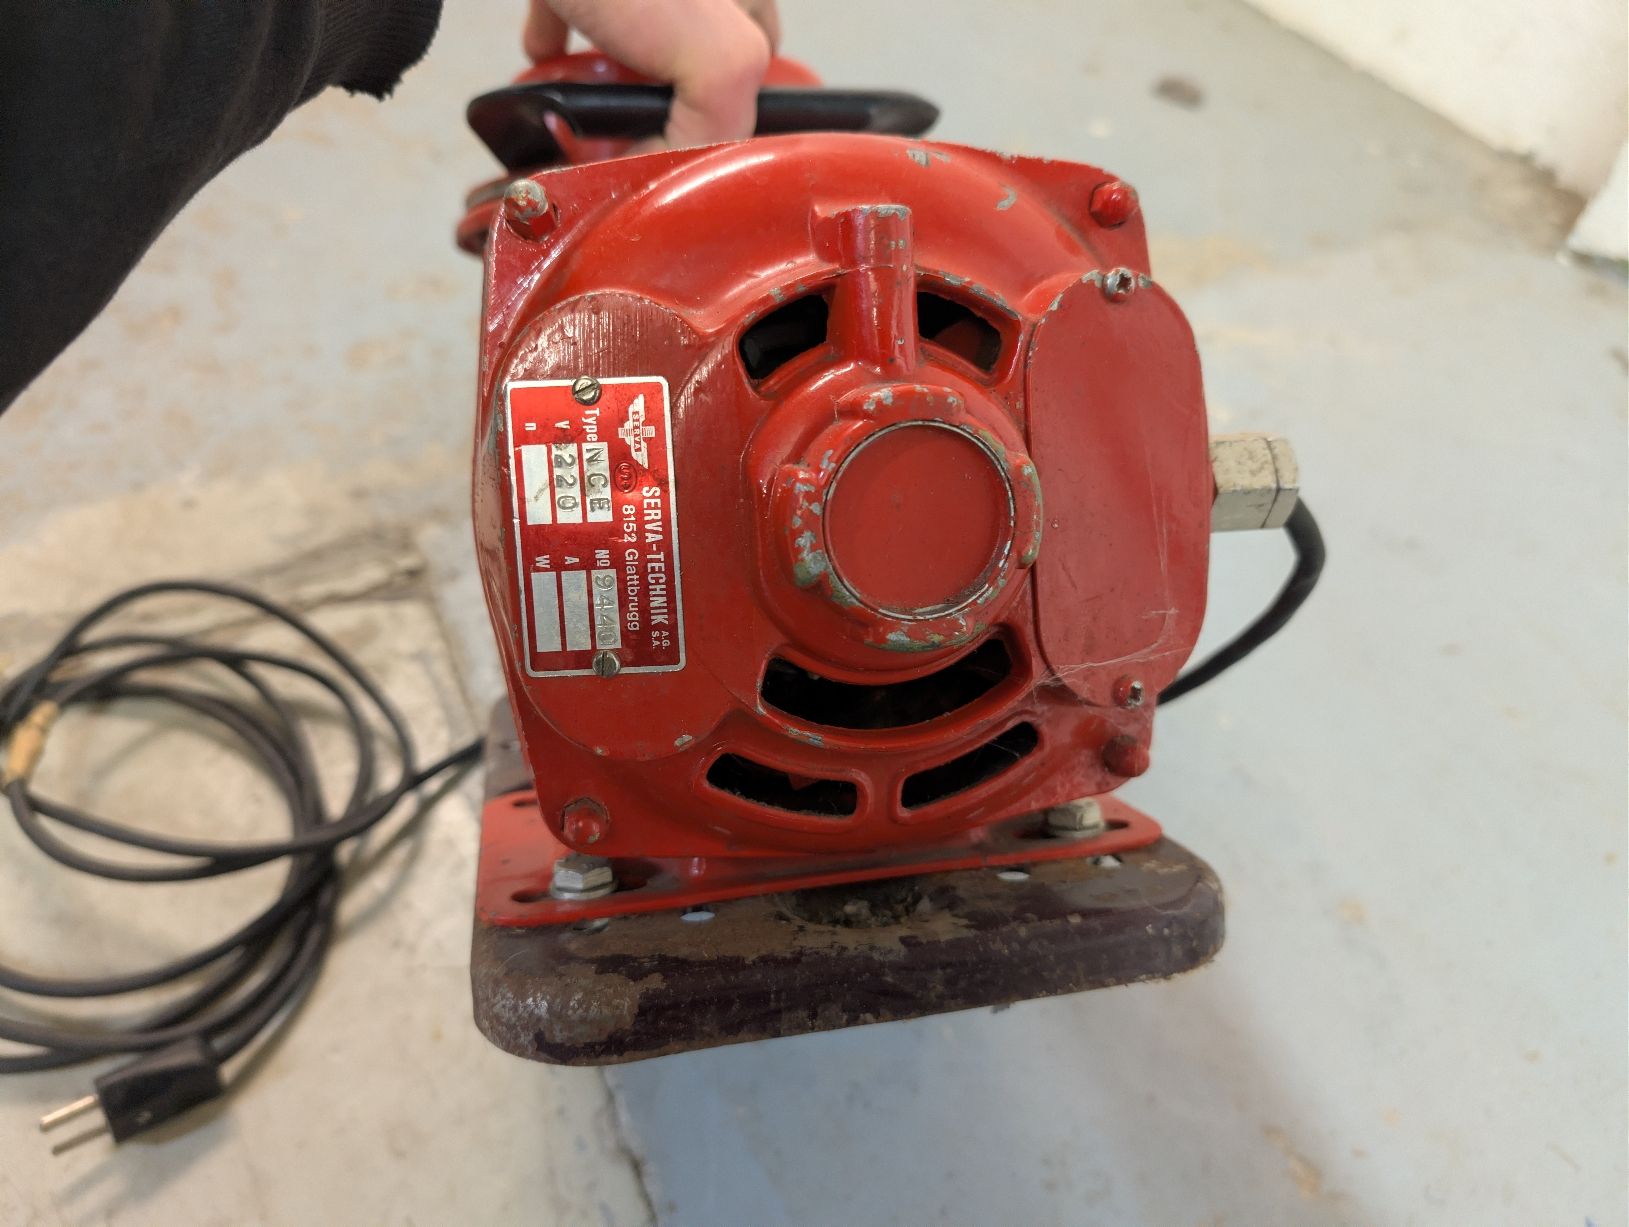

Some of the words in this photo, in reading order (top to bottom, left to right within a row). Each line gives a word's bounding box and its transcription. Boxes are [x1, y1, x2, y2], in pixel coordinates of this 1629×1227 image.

[525, 422, 536, 431] n
[555, 420, 570, 429] V
[582, 407, 600, 441] Type
[632, 410, 641, 452] SERVA
[585, 447, 610, 512] NCE
[622, 504, 637, 542] 8152
[535, 554, 551, 568] W
[565, 556, 580, 565] A
[642, 486, 669, 625] SERVA-TECHNIK
[625, 548, 640, 631] Glattbrugg
[651, 630, 660, 649] S.A.
[661, 630, 671, 650] A.G.
